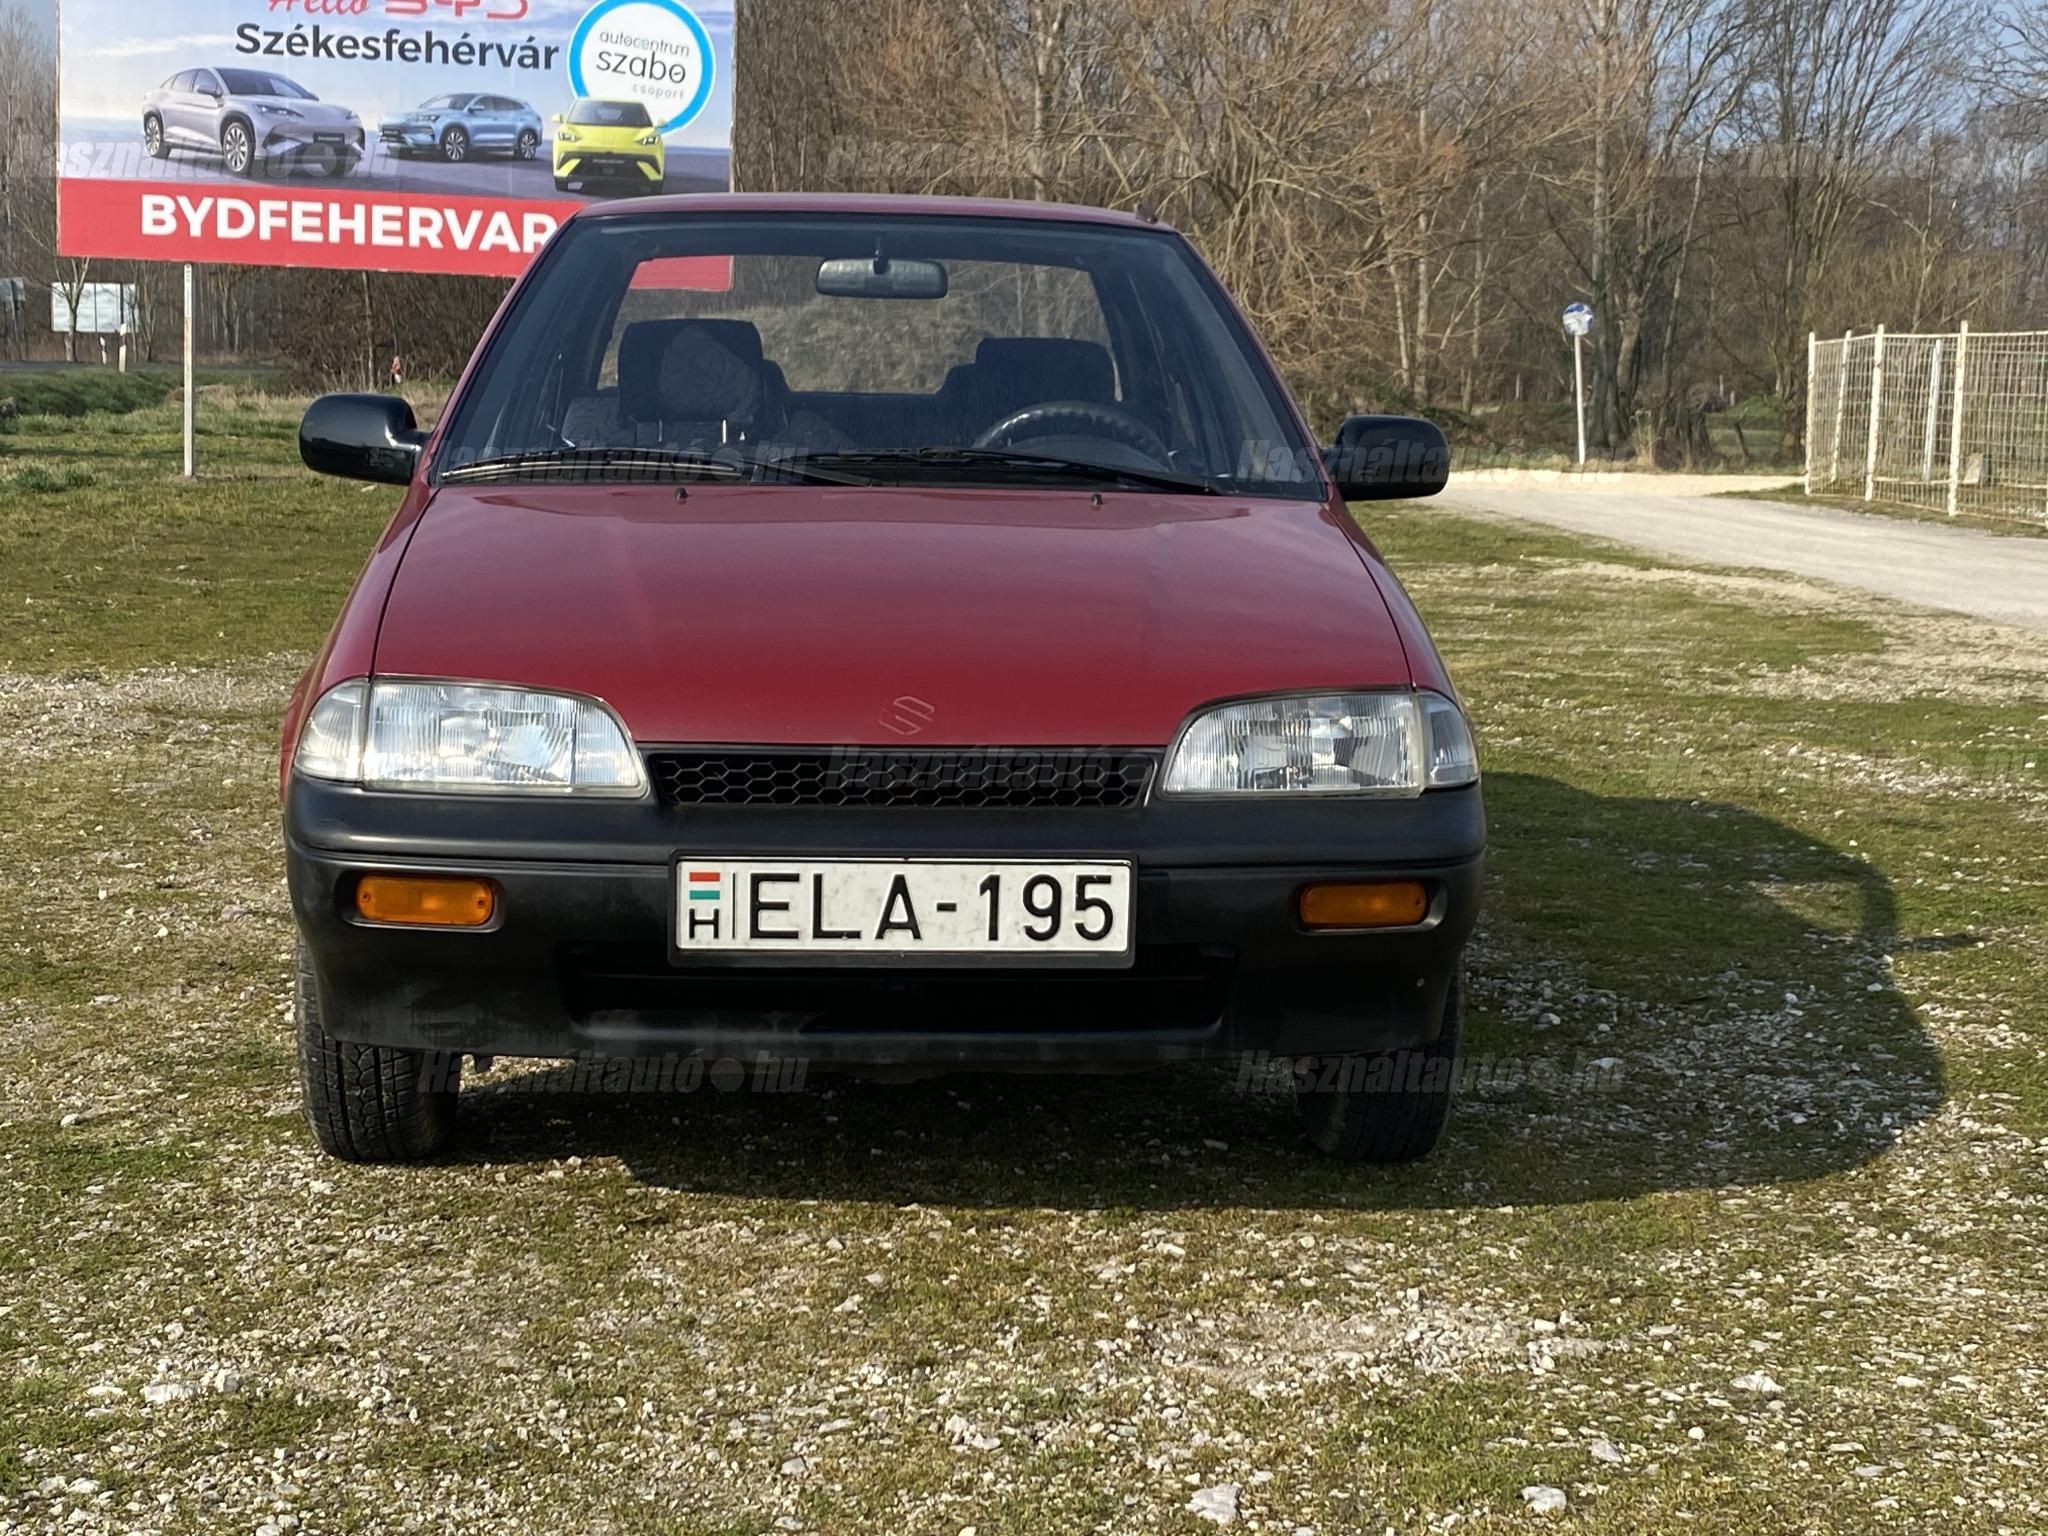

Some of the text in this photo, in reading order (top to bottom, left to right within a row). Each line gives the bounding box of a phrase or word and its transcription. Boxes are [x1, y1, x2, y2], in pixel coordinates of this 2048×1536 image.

[235, 22, 559, 70] Székesfehérvár
[599, 30, 690, 57] autocentrum
[633, 83, 685, 99] csoport
[141, 194, 558, 254] BYDFEHERVAR
[689, 872, 1114, 942] H ELA-195
